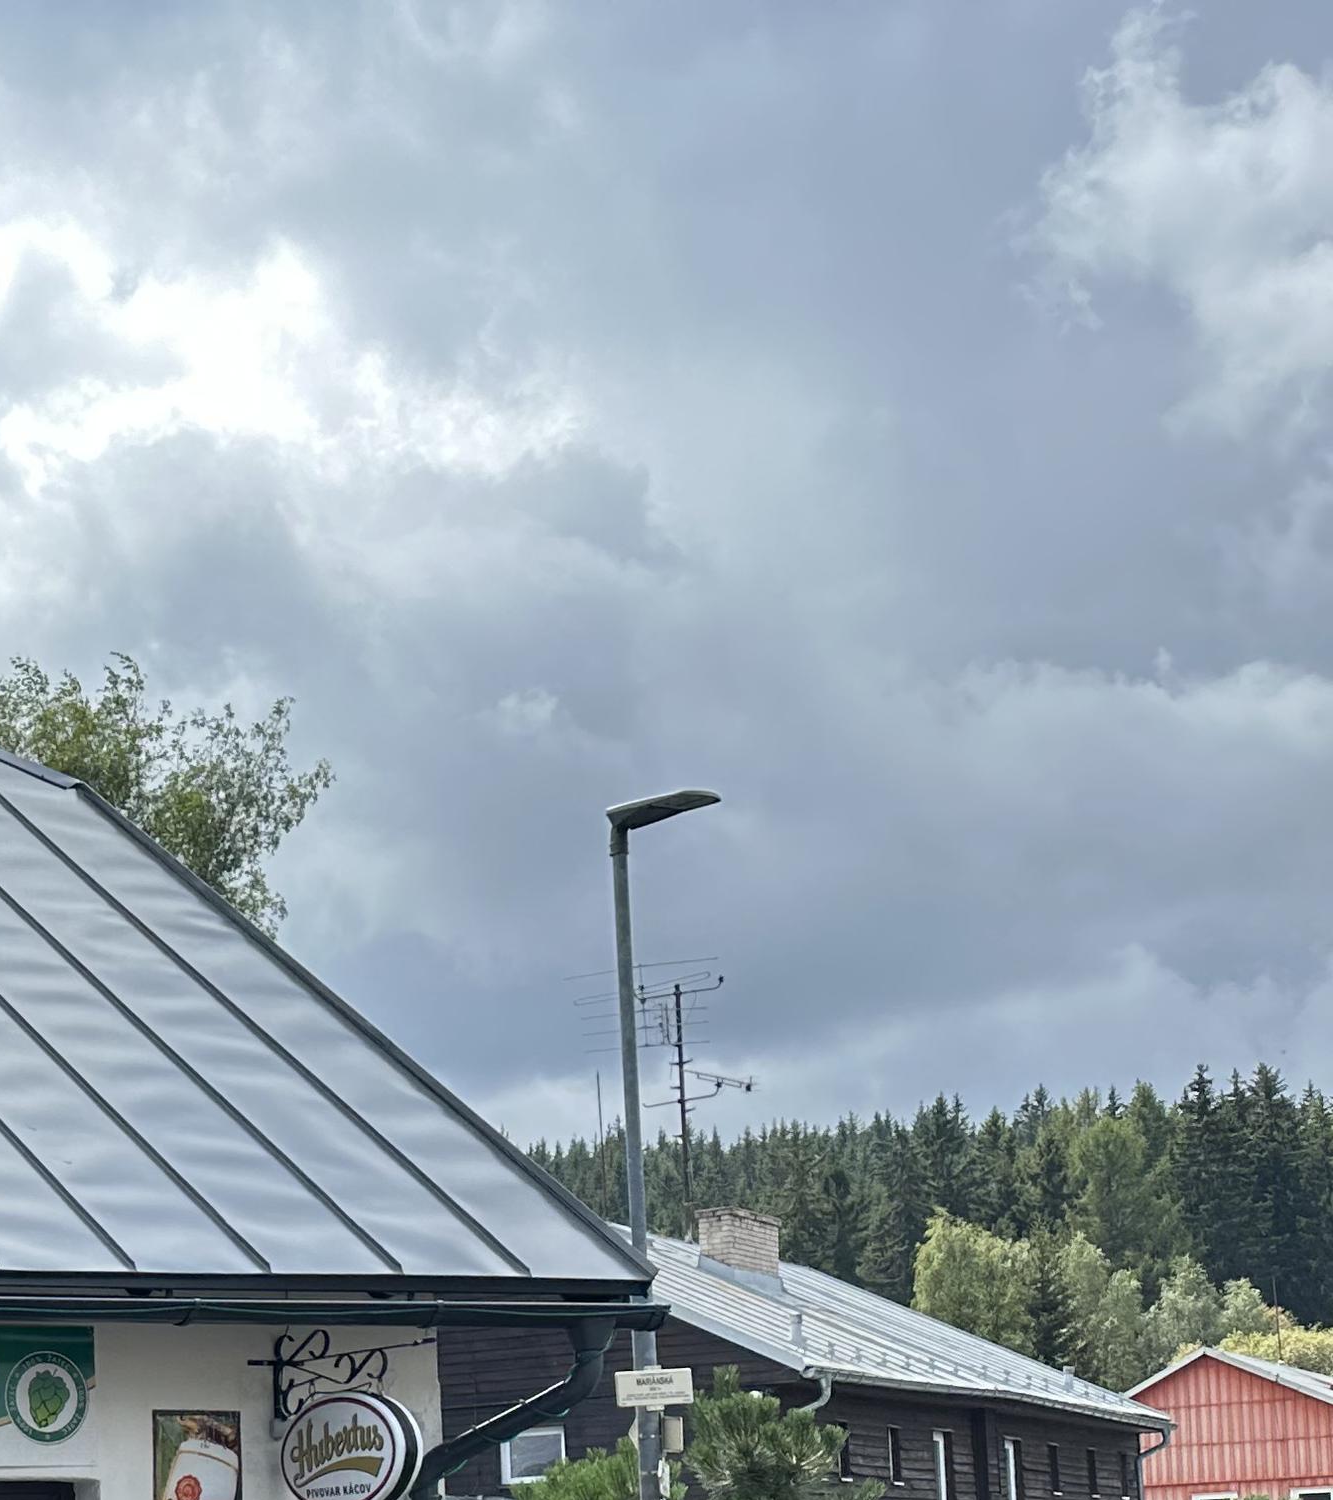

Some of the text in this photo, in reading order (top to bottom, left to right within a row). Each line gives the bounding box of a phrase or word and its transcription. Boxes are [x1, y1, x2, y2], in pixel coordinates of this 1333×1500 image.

[290, 1412, 384, 1478] Hubertus
[306, 1482, 371, 1499] PIVOVAR KÁCOV
